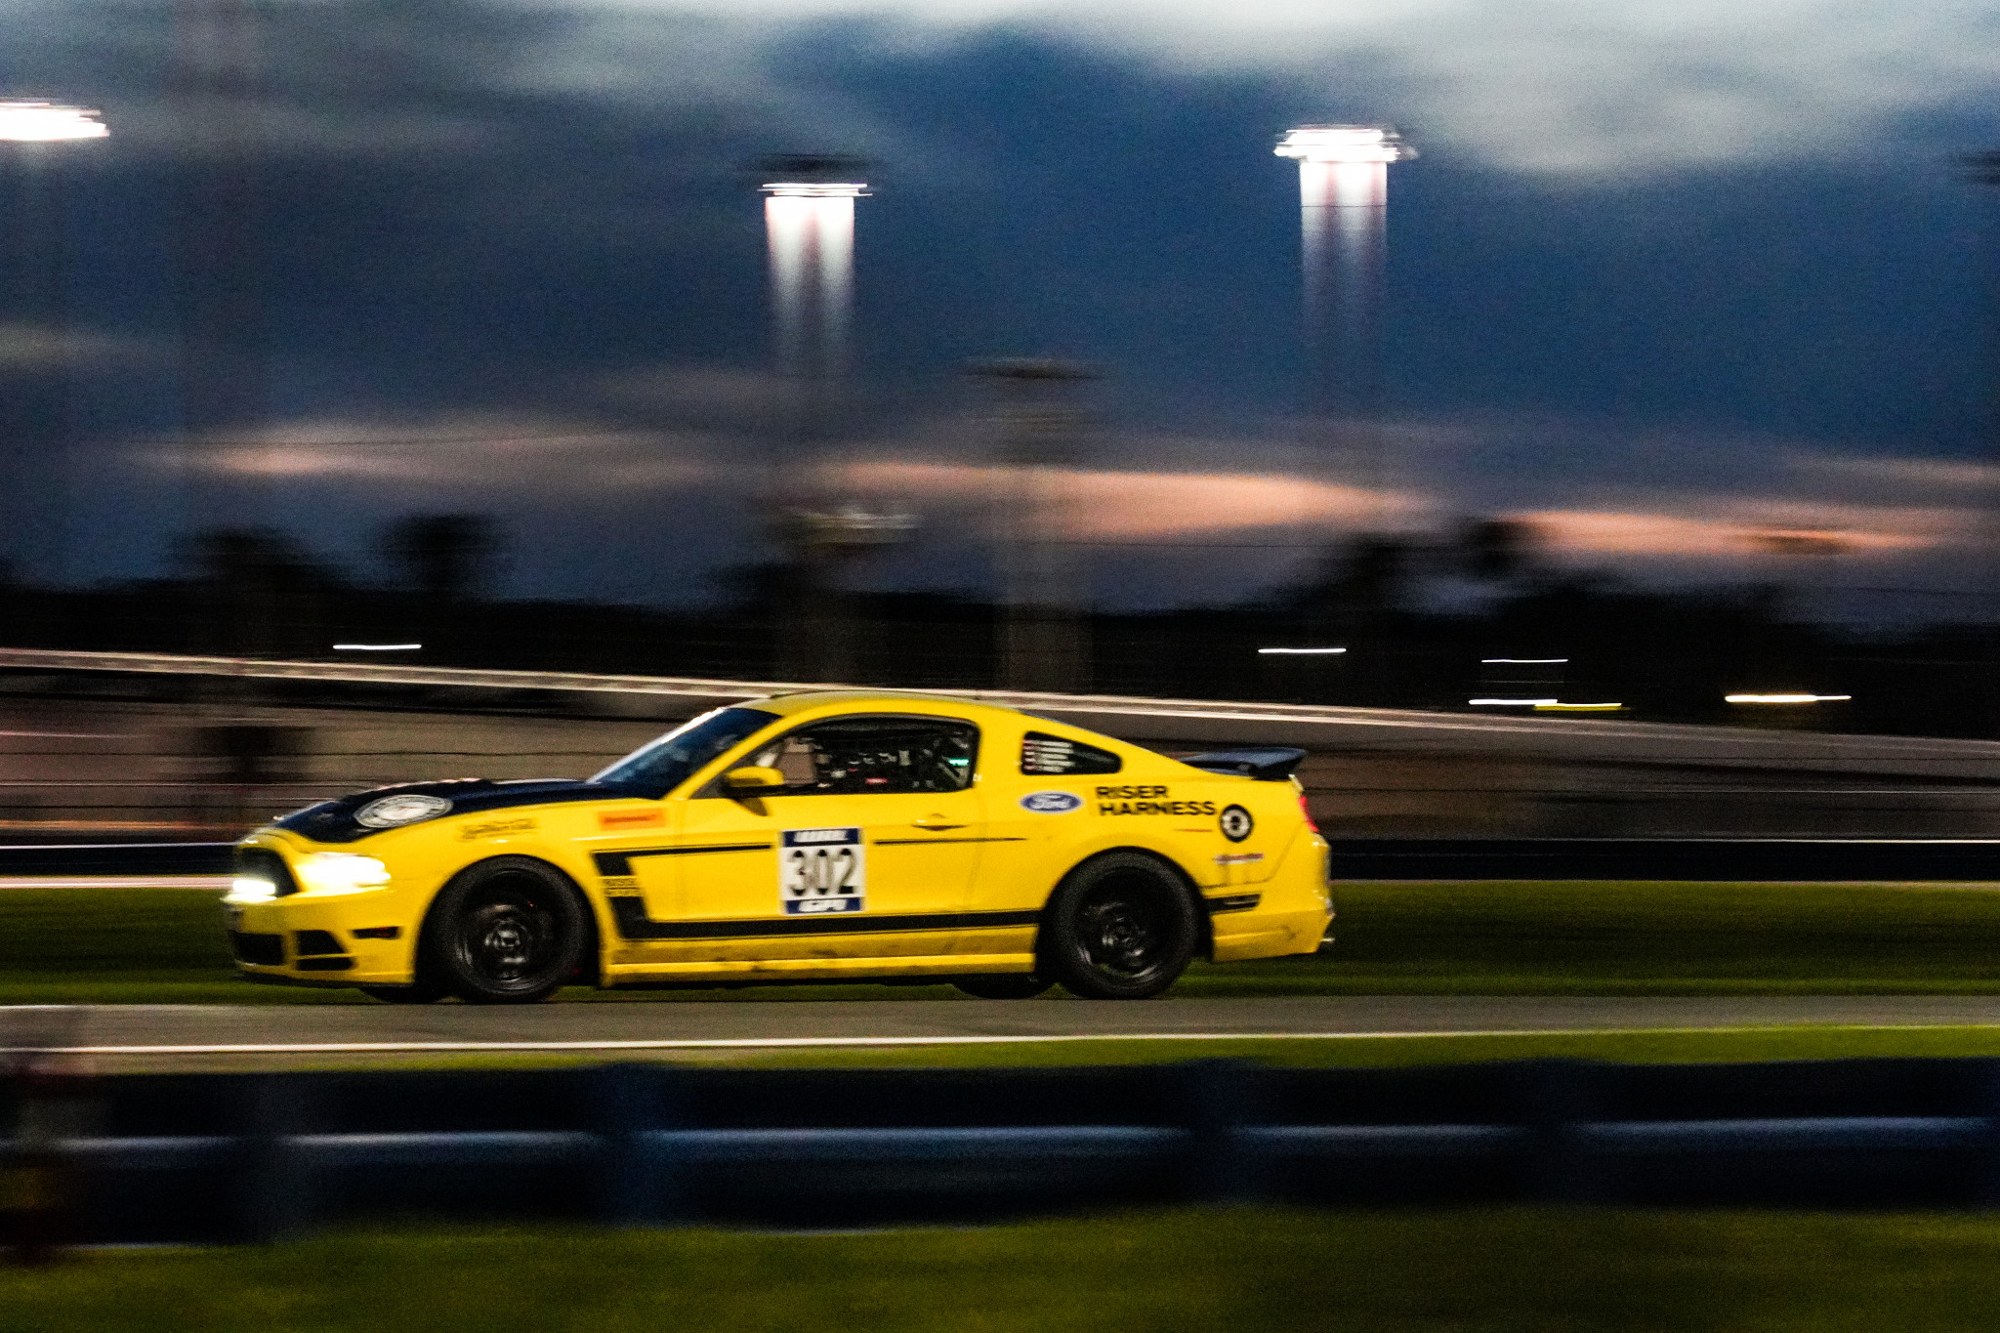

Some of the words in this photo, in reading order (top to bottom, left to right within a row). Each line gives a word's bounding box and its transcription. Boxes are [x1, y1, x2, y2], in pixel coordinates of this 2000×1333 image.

[1096, 786, 1168, 799] RISER
[1100, 801, 1217, 816] HARNESS
[787, 848, 857, 896] 302
